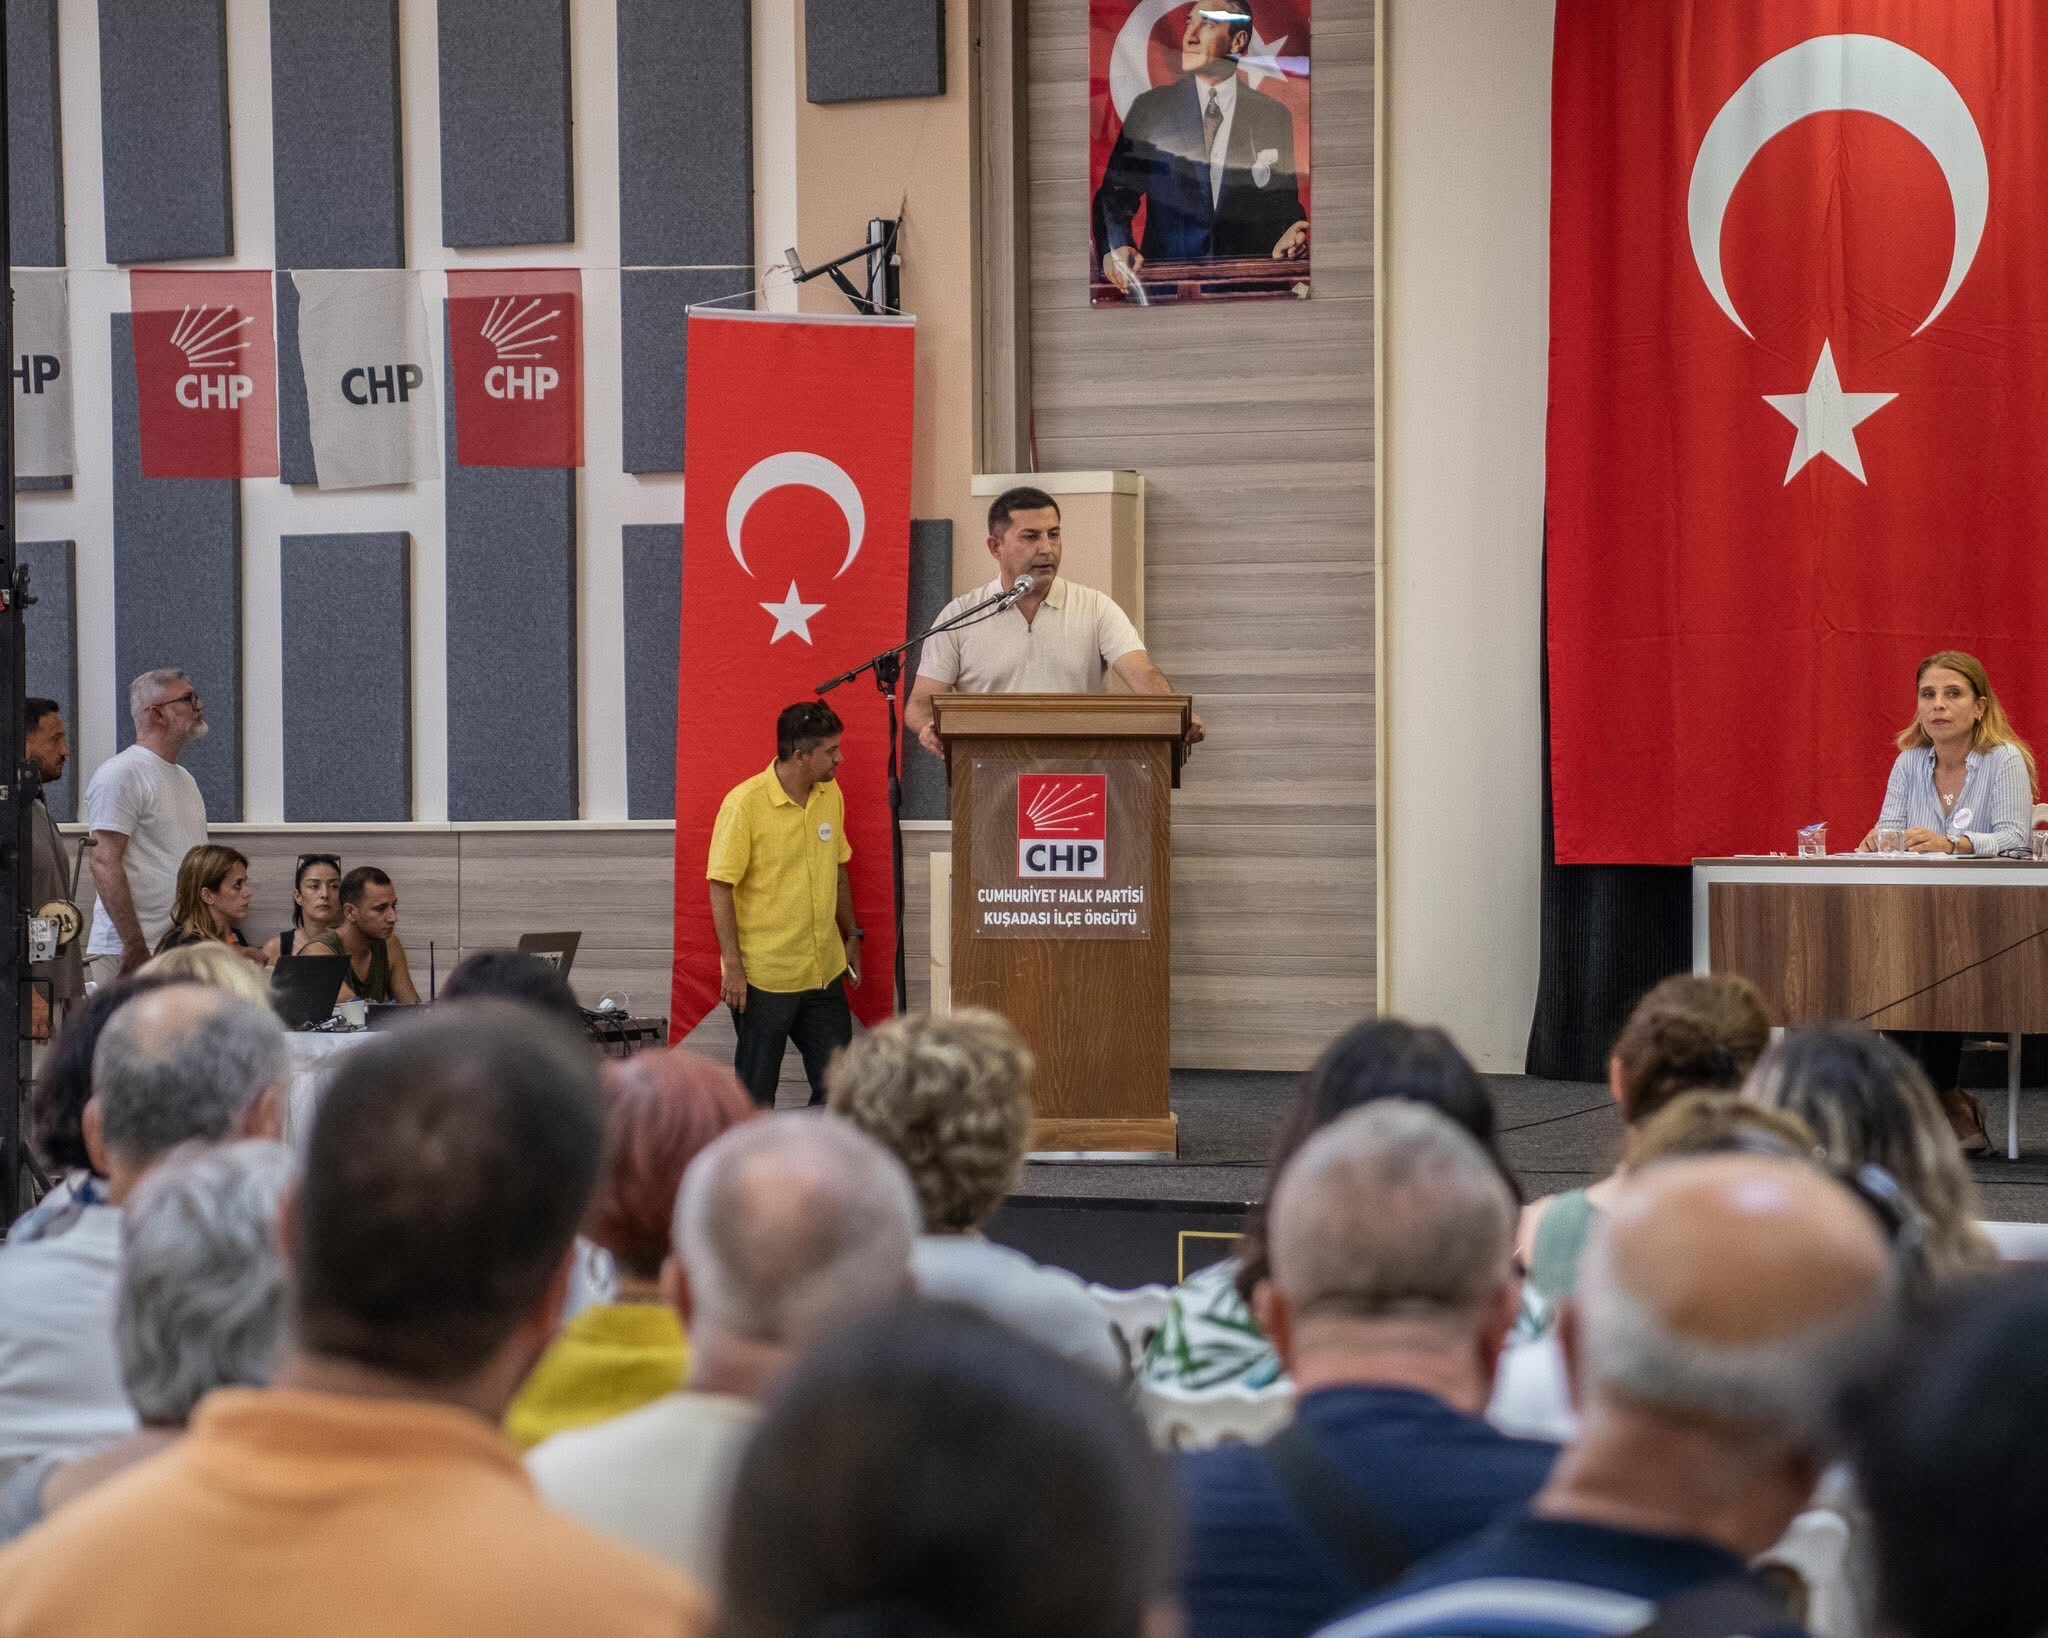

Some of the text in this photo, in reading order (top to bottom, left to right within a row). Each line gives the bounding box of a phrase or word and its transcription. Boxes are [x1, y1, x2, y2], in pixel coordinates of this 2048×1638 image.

[175, 374, 253, 409] CHP
[341, 363, 424, 405] CHP
[484, 366, 559, 399] CHP
[1025, 844, 1098, 872] CHP
[977, 885, 1144, 903] CUMHURİYET HALK PARTİSİ
[984, 909, 1137, 927] KUŞADASI İLÇE ÖRGÜTÜ
